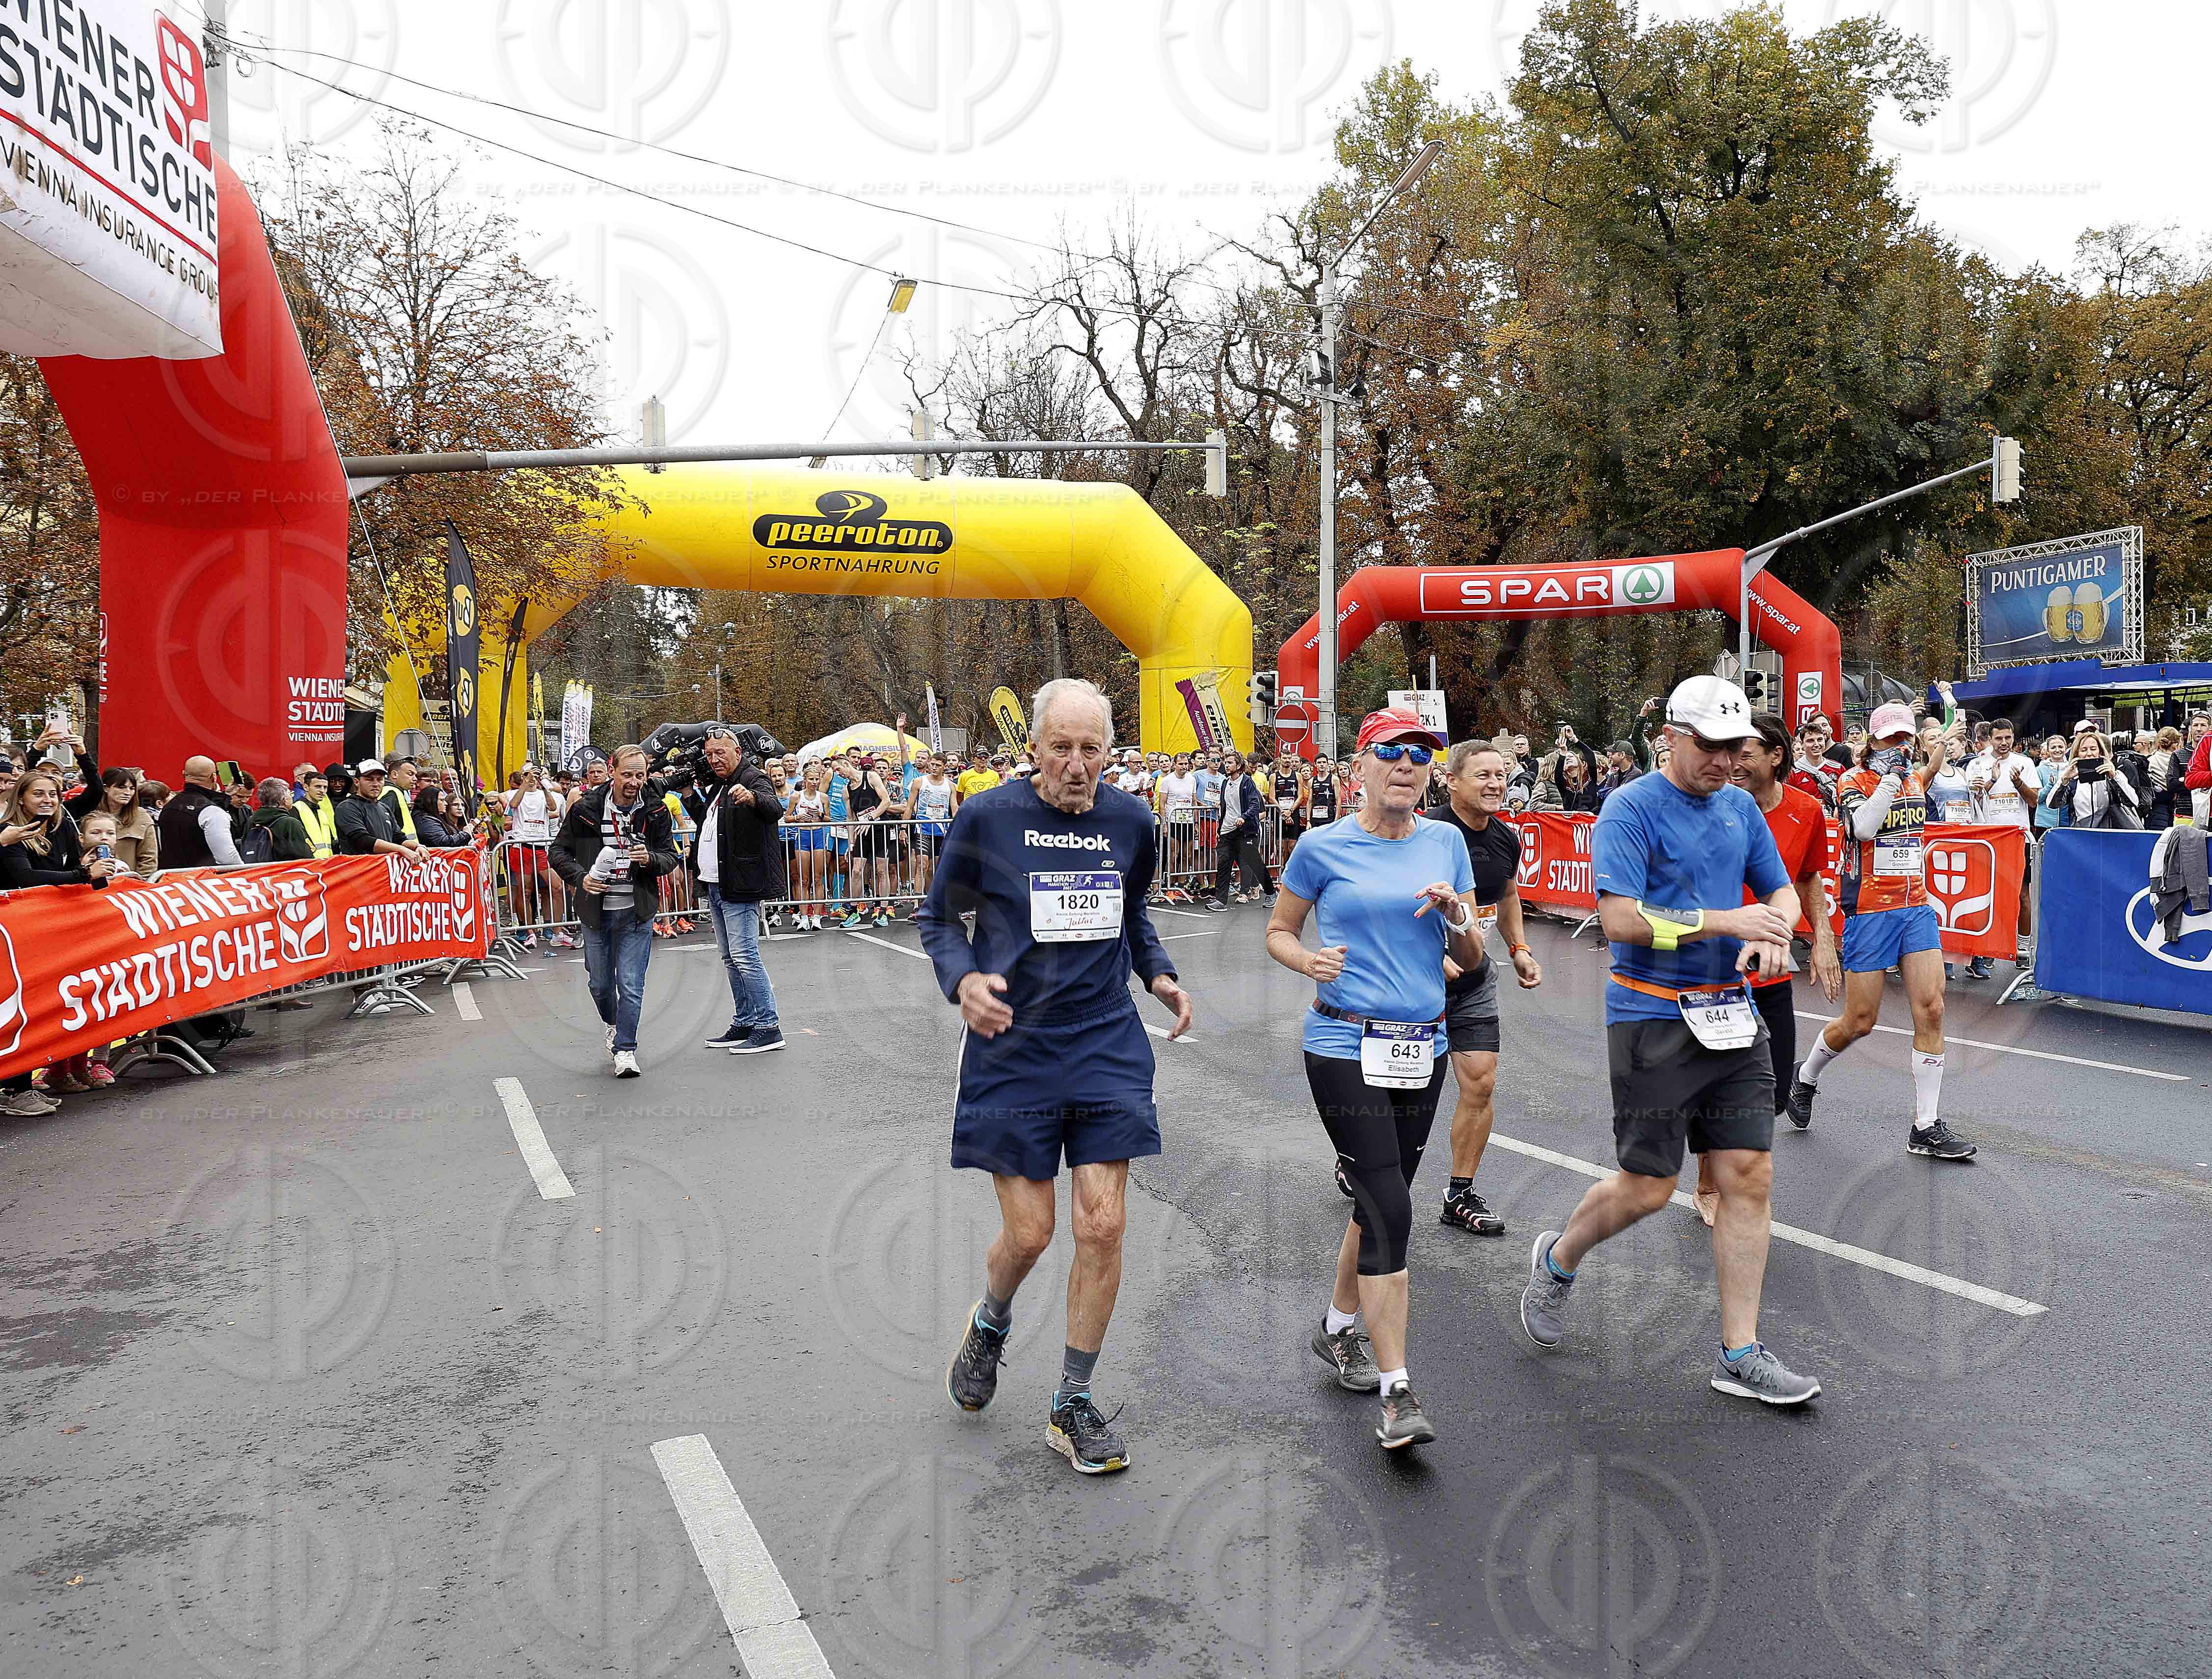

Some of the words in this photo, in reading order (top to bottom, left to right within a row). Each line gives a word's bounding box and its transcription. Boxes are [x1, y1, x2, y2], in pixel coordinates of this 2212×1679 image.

[0, 24, 216, 245] STÄDTISCHE
[0, 136, 78, 213] VIENNA
[84, 190, 175, 275] INSURANCE
[767, 521, 938, 546] peeroton
[766, 555, 940, 574] SPORTNAHRUNG
[1991, 555, 2106, 594] PUNTIGAMER
[1460, 574, 1609, 605] SPAR
[1748, 588, 1801, 635] ww.spar.at
[1193, 709, 1207, 735] Ausdauer
[1206, 705, 1225, 748] ener
[1432, 715, 1437, 726] 1
[288, 732, 323, 741] VIENNA
[760, 738, 775, 750] Buff
[1884, 807, 1926, 829] APERO
[1024, 829, 1111, 852] Reebok
[1892, 849, 1909, 858] 659
[385, 853, 451, 894] WIENER
[1547, 859, 1592, 894] STÄDTI
[105, 876, 278, 939] WIENER
[1057, 894, 1099, 910] 1820
[345, 902, 451, 951] STÄDTISCHE
[58, 920, 279, 1031] STÄDTISCHE
[1705, 1008, 1730, 1023] 644
[1391, 1044, 1420, 1059] 643
